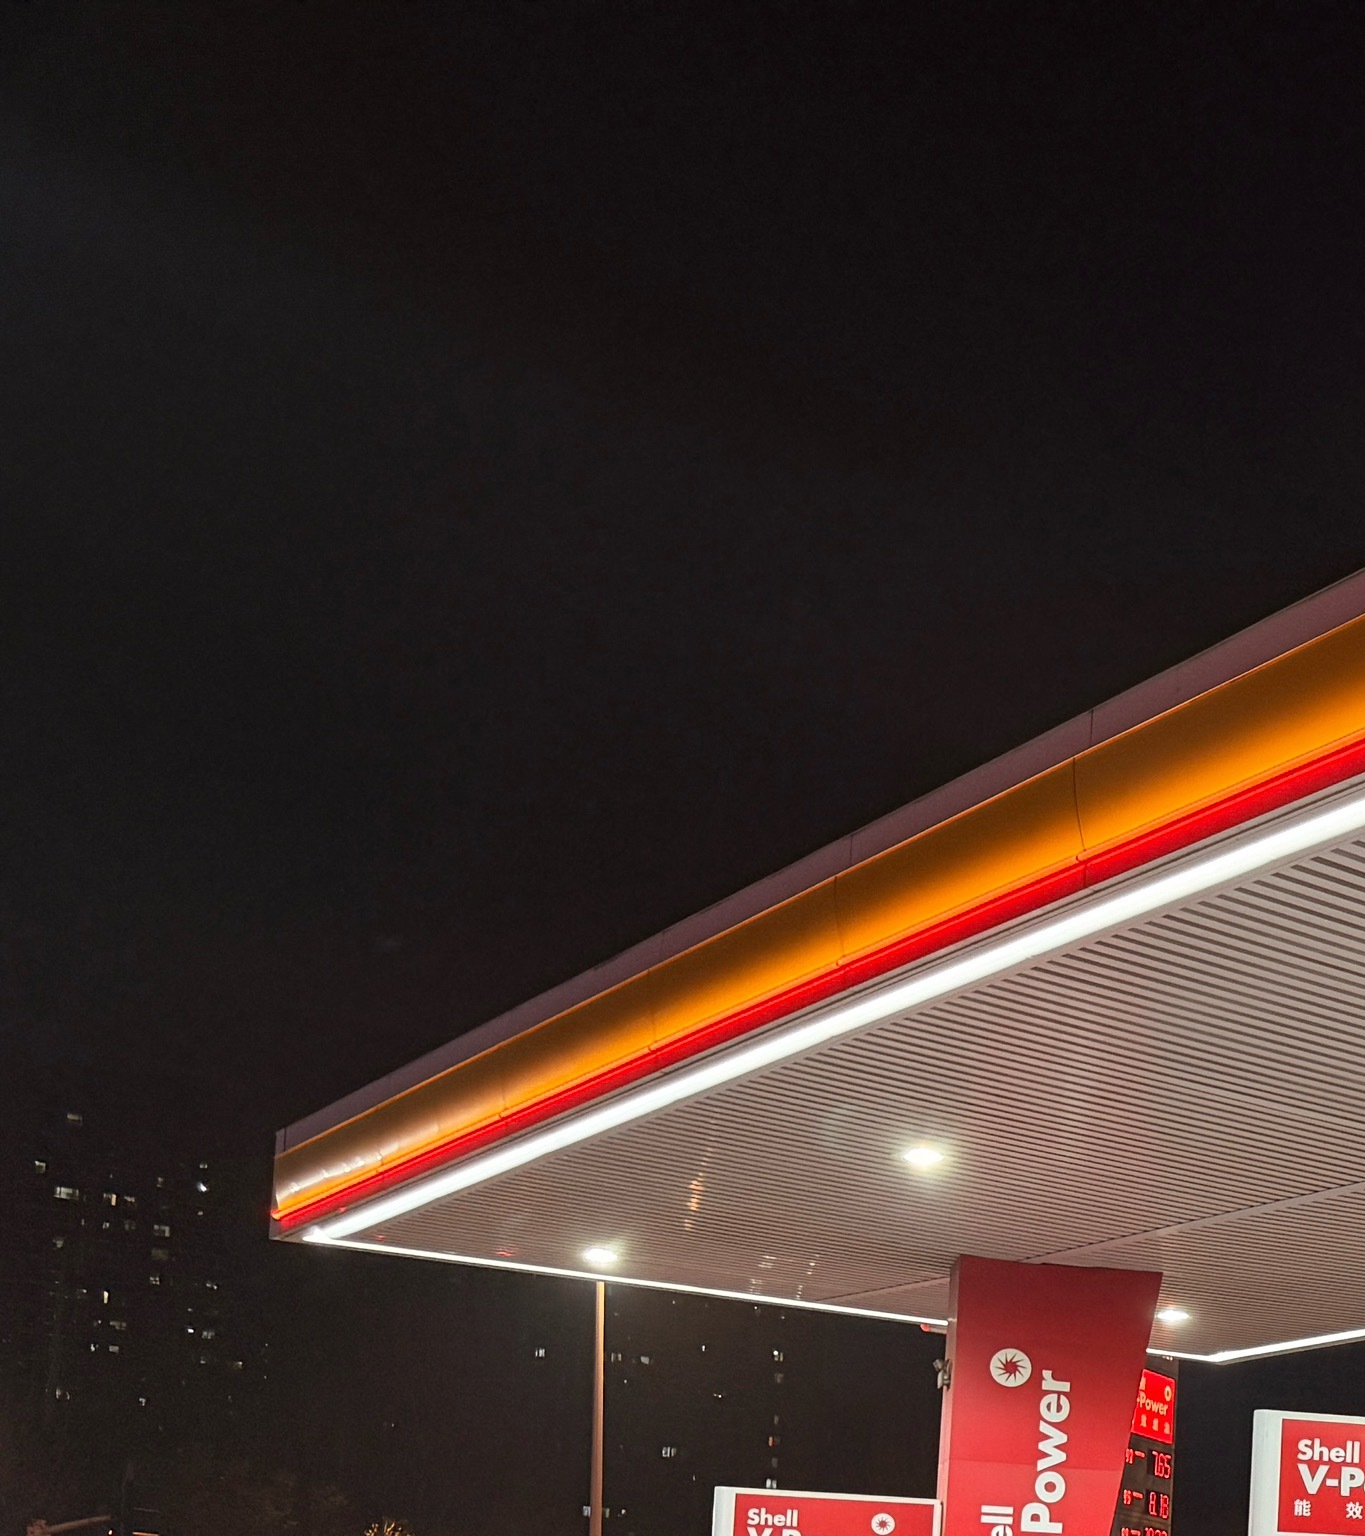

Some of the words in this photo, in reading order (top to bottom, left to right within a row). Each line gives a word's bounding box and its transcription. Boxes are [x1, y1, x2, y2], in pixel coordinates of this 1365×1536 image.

[1136, 1391, 1168, 1417] -Power
[1297, 1437, 1361, 1464] Shell
[747, 1507, 798, 1527] Shell
